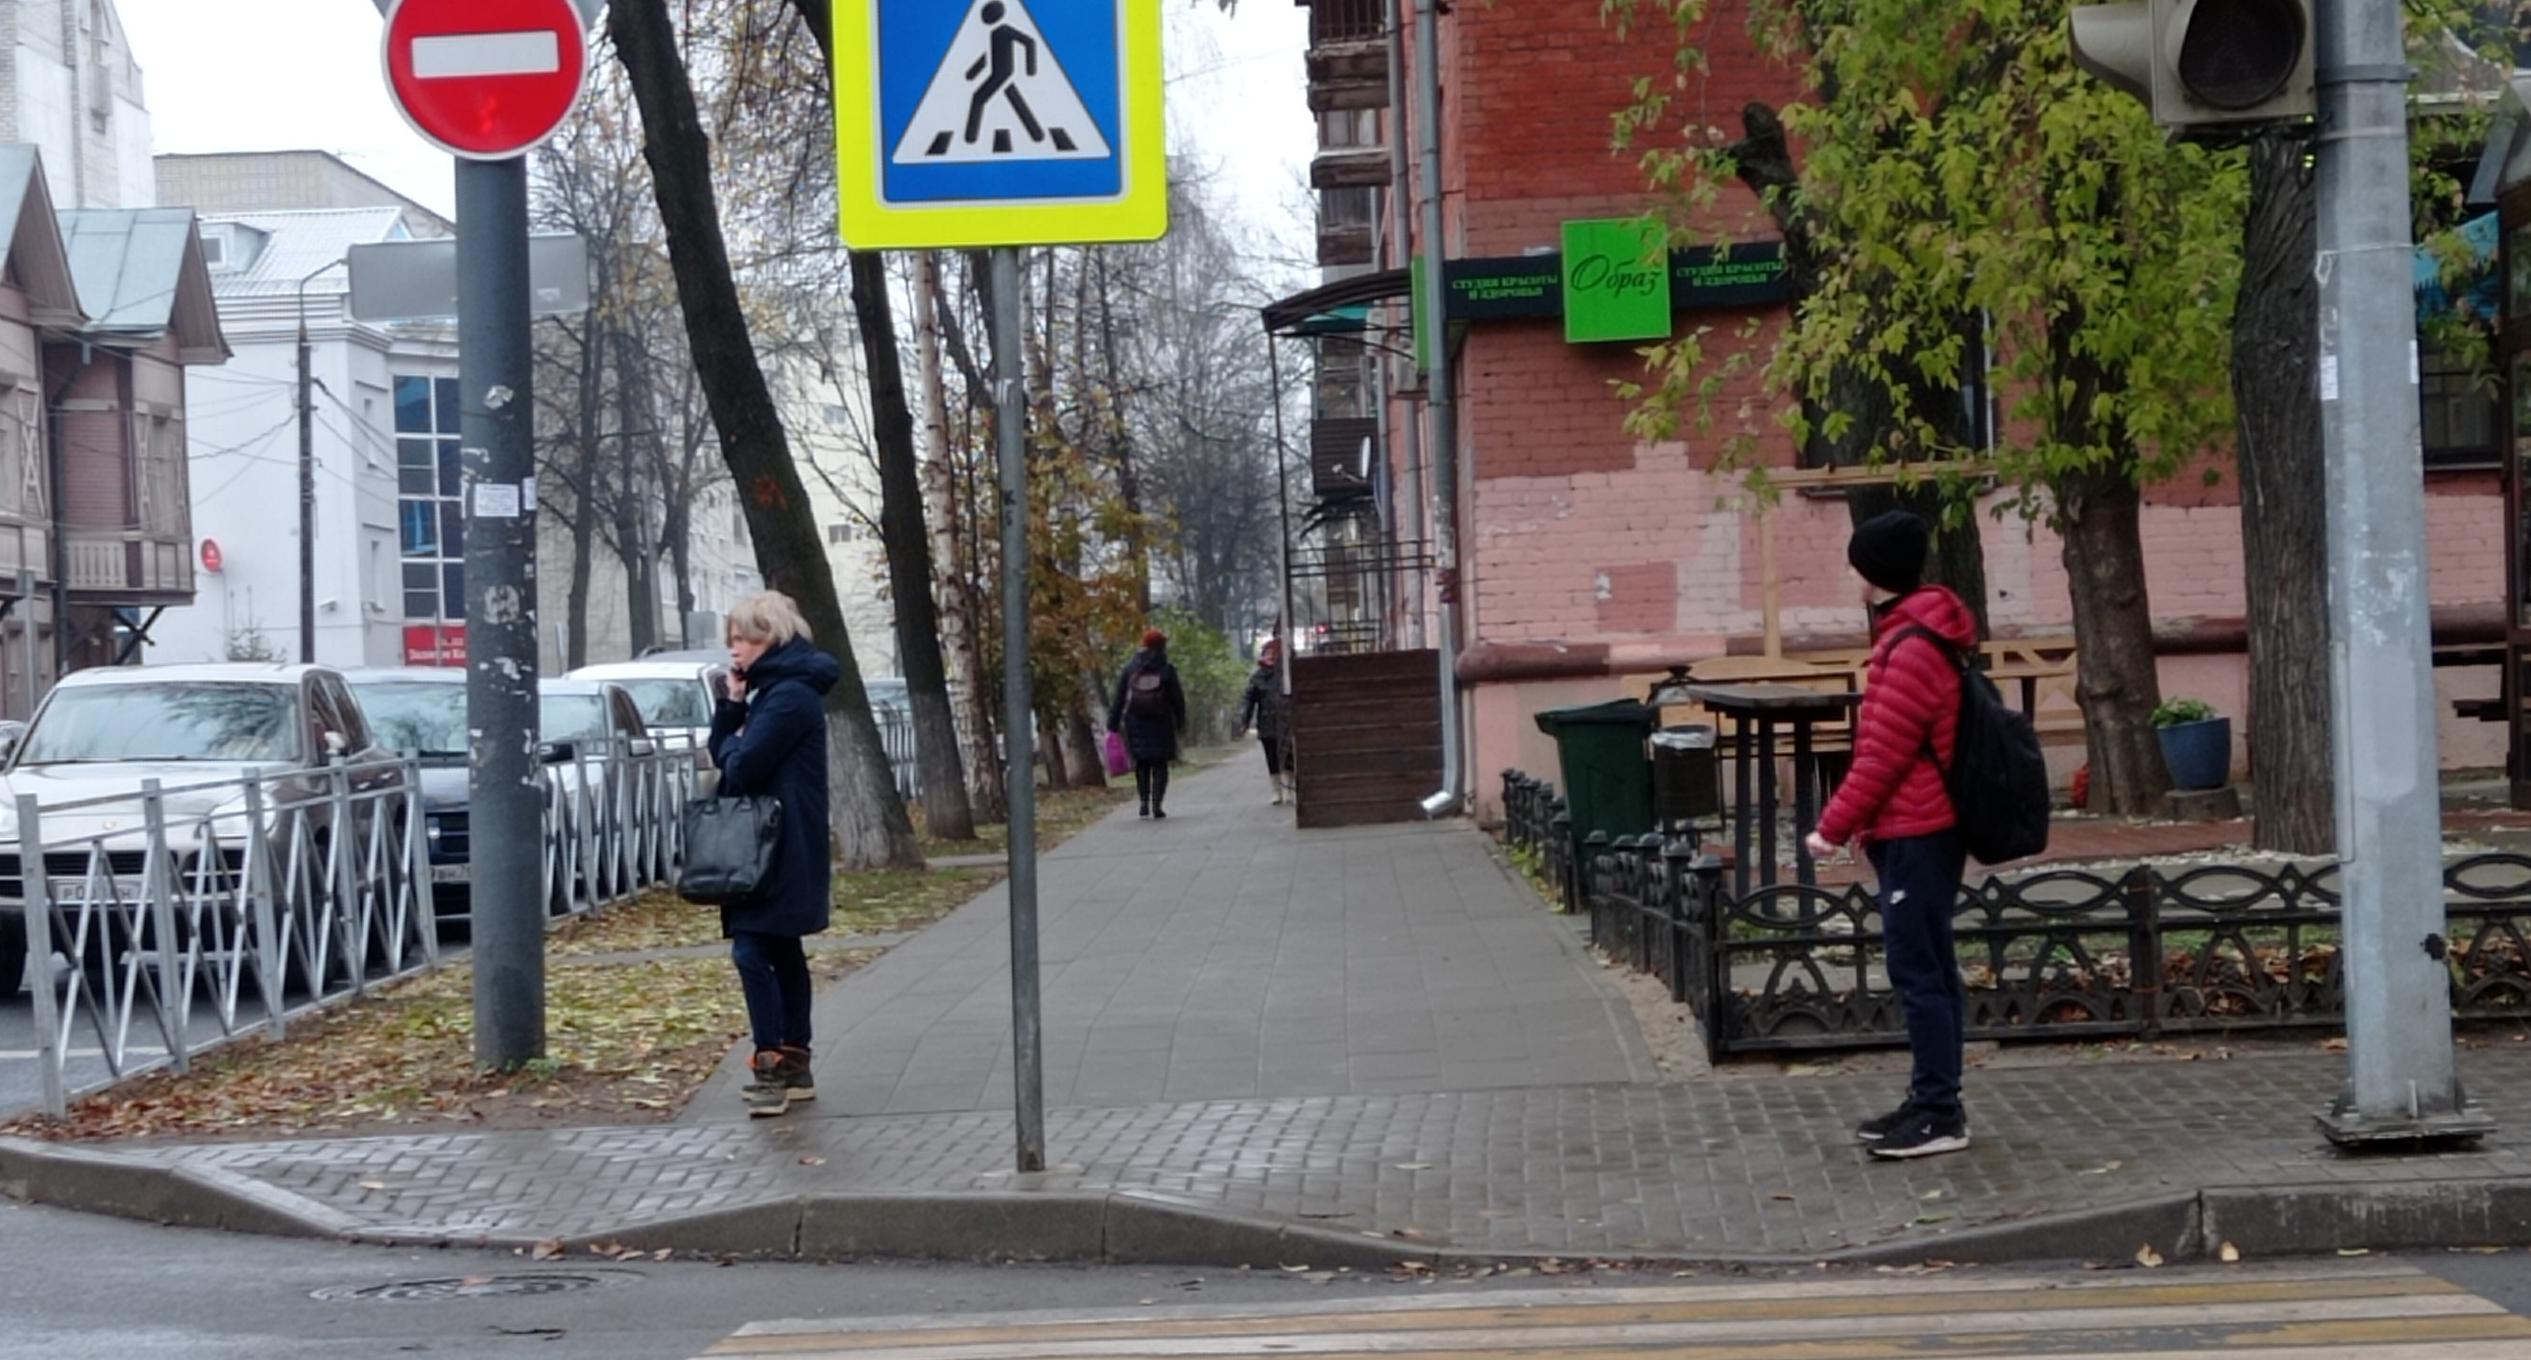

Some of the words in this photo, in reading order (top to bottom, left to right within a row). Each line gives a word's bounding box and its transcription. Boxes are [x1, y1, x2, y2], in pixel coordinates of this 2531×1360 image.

[1452, 278, 1499, 289] СТУДИЯ
[1502, 274, 1558, 287] КРАСОТЫ
[1570, 254, 1662, 299] Образ
